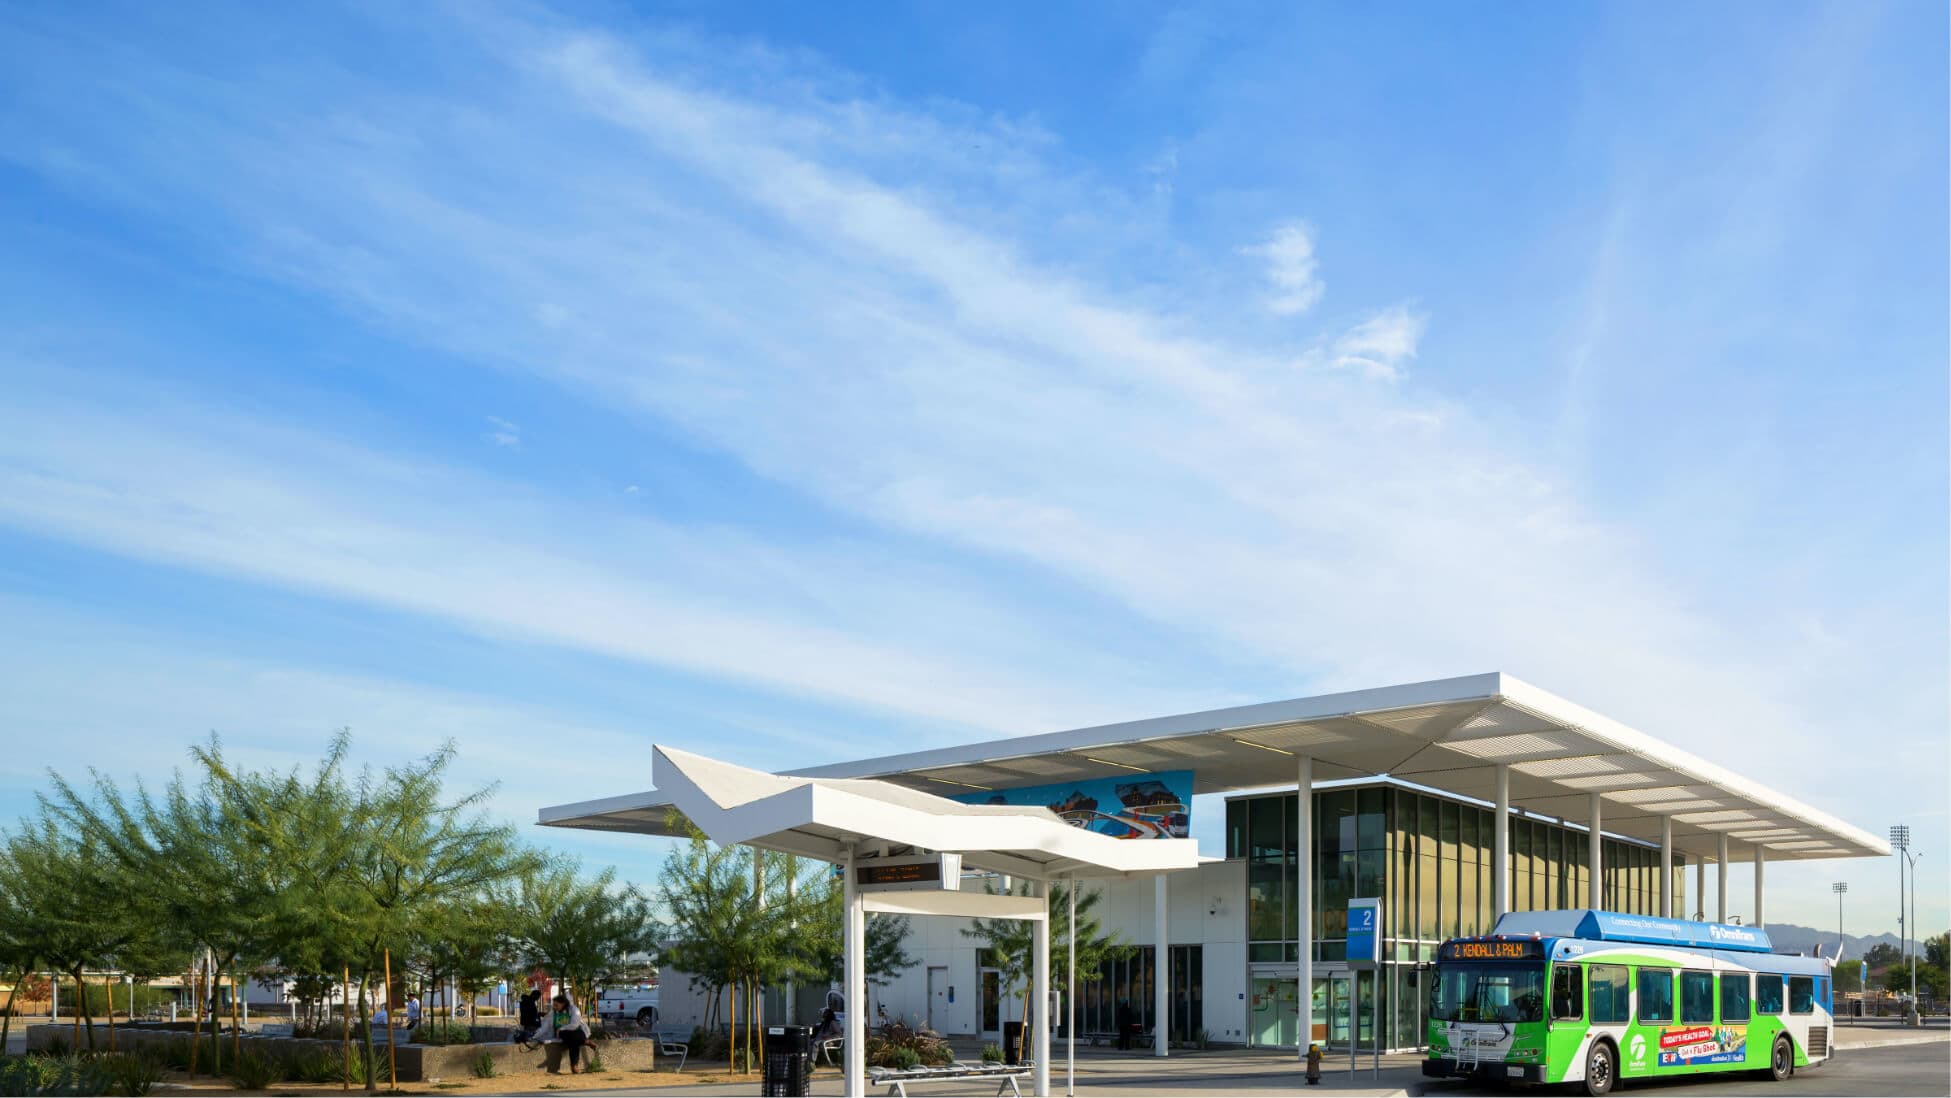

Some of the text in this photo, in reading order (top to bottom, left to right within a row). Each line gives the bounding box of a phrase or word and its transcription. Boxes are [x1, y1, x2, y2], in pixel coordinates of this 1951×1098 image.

[1363, 910, 1372, 926] 2
[1454, 944, 1460, 957] 2
[1463, 943, 1494, 957] KENDALL
[1503, 943, 1523, 957] PALM
[1682, 1031, 1698, 1041] HEALTH
[1693, 1046, 1702, 1055] Flu
[1703, 1043, 1715, 1053] Shot
